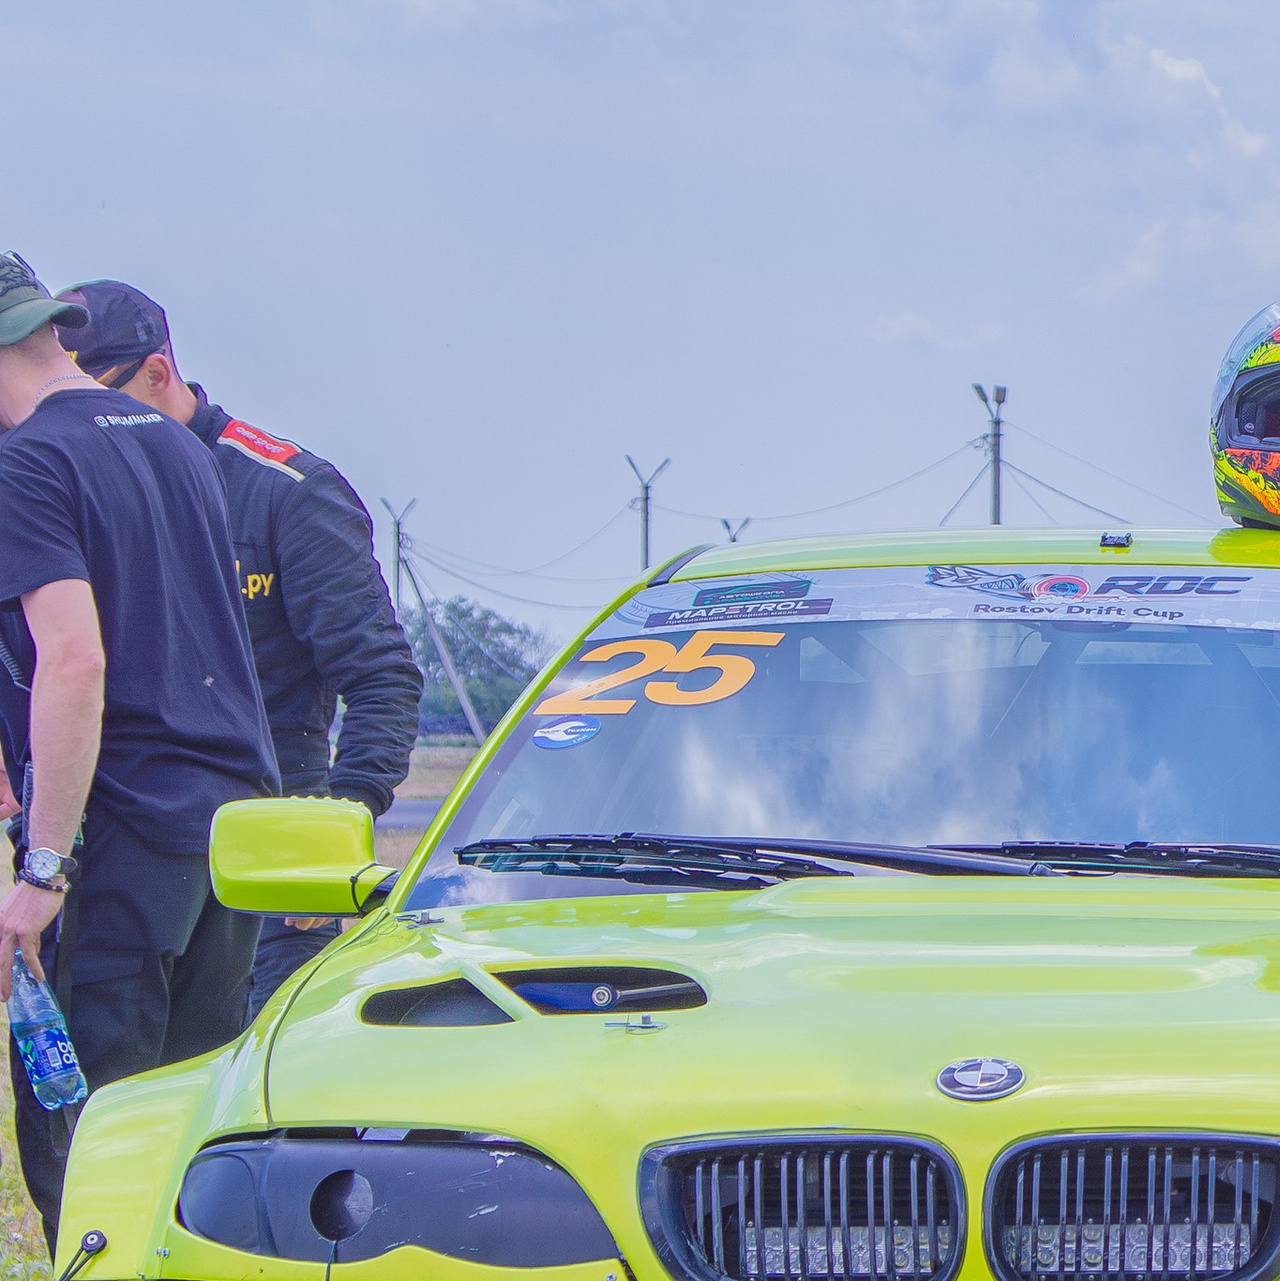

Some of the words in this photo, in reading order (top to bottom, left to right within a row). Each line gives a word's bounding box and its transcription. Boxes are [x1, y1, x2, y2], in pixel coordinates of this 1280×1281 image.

[1094, 576, 1254, 595] RDC
[667, 600, 810, 620] MAPETROL
[973, 604, 1059, 615] Rostov
[1066, 604, 1126, 616] Drift
[1133, 607, 1184, 621] Cup
[532, 630, 786, 716] 25
